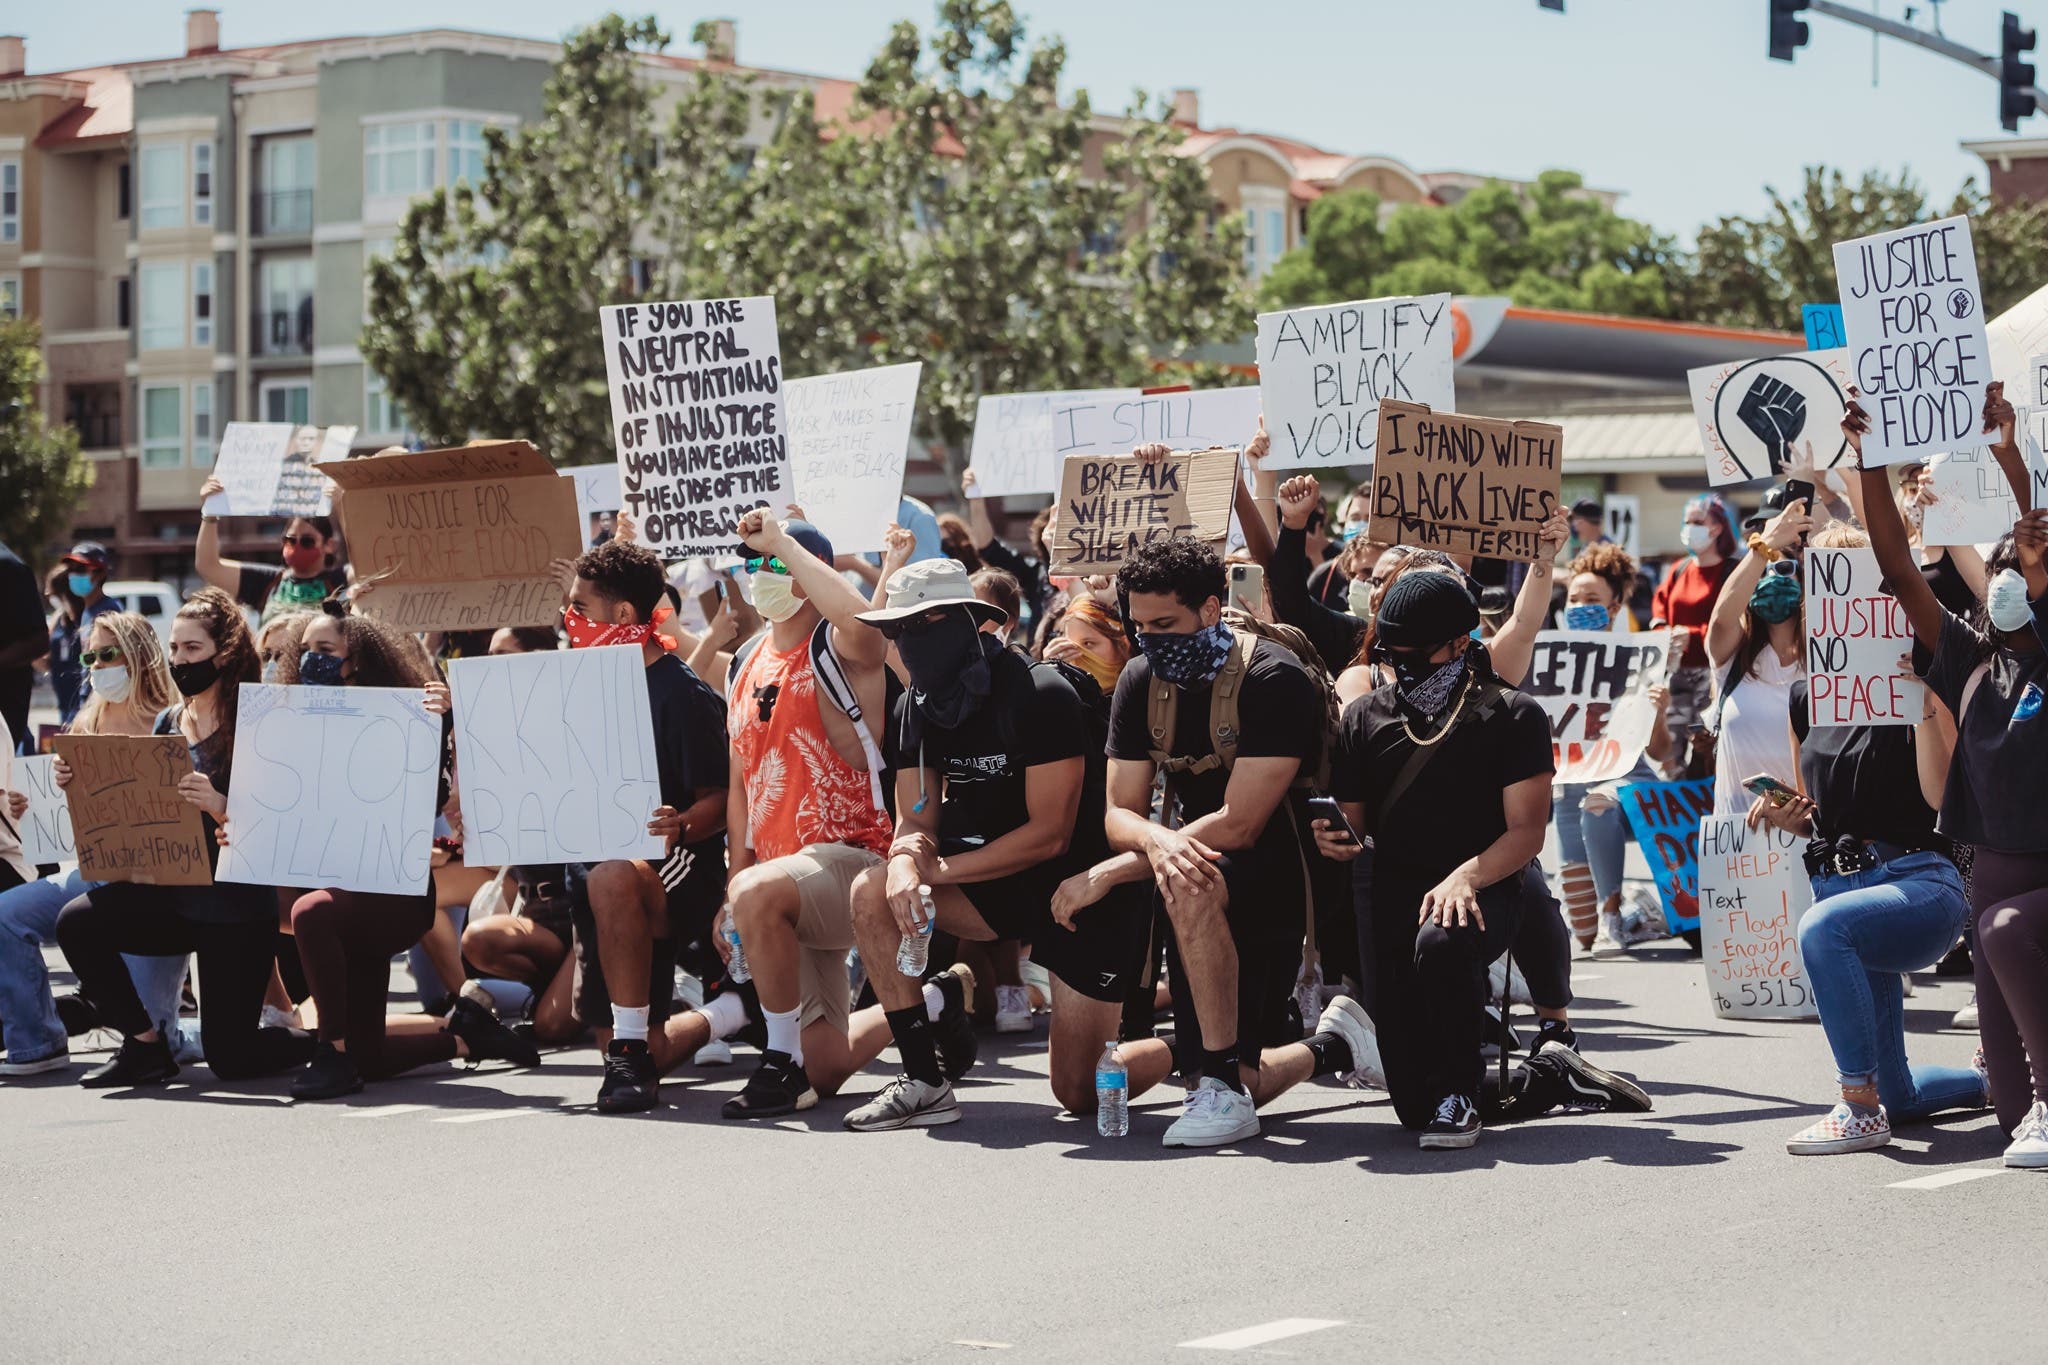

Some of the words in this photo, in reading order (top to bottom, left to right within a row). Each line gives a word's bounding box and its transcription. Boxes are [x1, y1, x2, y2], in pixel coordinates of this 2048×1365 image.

[1851, 226, 1964, 299] JUSTICE
[616, 306, 639, 338] IF
[648, 303, 693, 333] YOU
[704, 300, 745, 327] ARE
[1272, 302, 1444, 361] AMPLIFY
[1879, 292, 1938, 339] FOR
[618, 327, 750, 380] NEUTRAL
[1858, 334, 1979, 396] GEORGE
[622, 381, 647, 414] IN
[650, 355, 779, 407] SITUATIONS
[823, 374, 879, 408] THINK
[1313, 351, 1413, 408] BLACK
[1705, 362, 1740, 403] LIVES
[621, 418, 649, 449] OF
[655, 402, 777, 447] INJUSTICE
[880, 400, 907, 423] IT
[996, 397, 1053, 432] BLA
[1056, 405, 1097, 455] I
[1111, 397, 1213, 445] STILL
[1287, 408, 1378, 459] VOIC
[1879, 389, 1973, 448] FLOYD
[625, 451, 667, 492] YOU
[668, 444, 722, 477] HAVE
[722, 434, 786, 469] CHOSEN
[999, 431, 1053, 450] LIVE
[1387, 414, 1407, 455] I
[1414, 420, 1485, 467] STAND
[1491, 431, 1555, 470] WITH
[1705, 422, 1738, 477] BLACK
[625, 484, 671, 517] THE
[671, 476, 713, 509] SIDE
[713, 472, 736, 499] OF
[735, 466, 781, 495] THE
[1081, 461, 1182, 497] BREAK
[1377, 470, 1469, 518] BLACK
[1479, 471, 1556, 526] LIVES
[386, 489, 464, 531] JUSTICE
[476, 484, 519, 528] FOR
[1070, 492, 1175, 528] WHITE
[372, 529, 465, 582] GEORGE
[473, 526, 551, 578] FLOYD
[665, 544, 714, 558] DESMOND
[1397, 518, 1541, 560] MATTER!!!
[1811, 552, 1852, 597] NO
[1809, 636, 1848, 673] NO
[1811, 673, 1904, 726] PEACE
[250, 706, 440, 828] STOP
[69, 795, 120, 831] Lives
[122, 788, 187, 821] Matter
[1633, 777, 1715, 828] HAN
[33, 804, 76, 856] NO
[79, 835, 204, 874] #Justice4Floyd
[228, 817, 431, 885] KILLING
[1703, 820, 1746, 857] HOW
[1702, 887, 1747, 910] Text
[1714, 991, 1732, 1012] to
